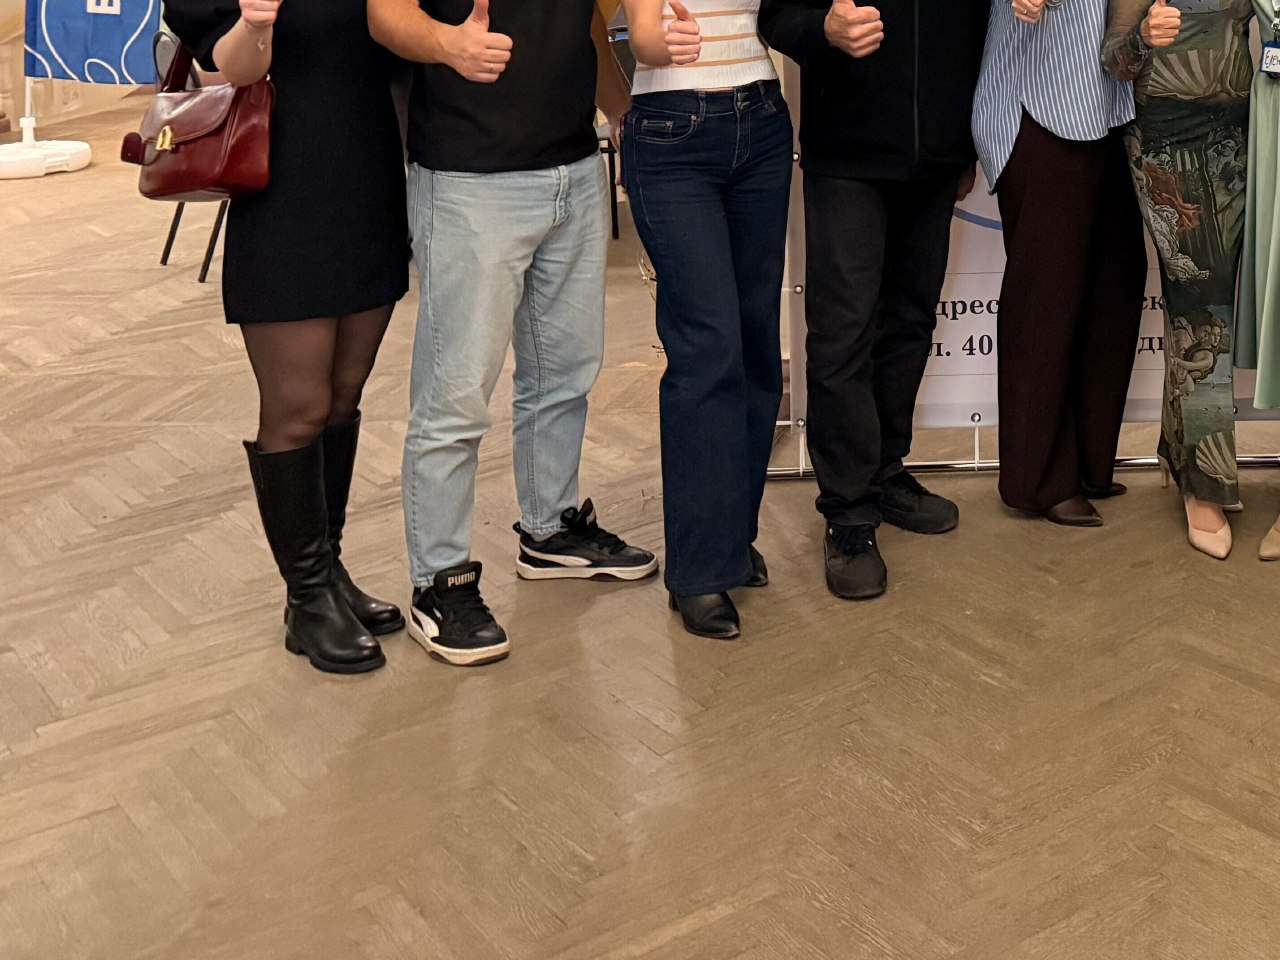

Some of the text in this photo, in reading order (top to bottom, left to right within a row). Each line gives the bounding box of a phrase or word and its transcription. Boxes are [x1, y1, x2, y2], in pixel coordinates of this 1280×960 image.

[935, 299, 999, 320] дрес
[929, 334, 993, 357] л. 40
[447, 571, 476, 587] PUMA
